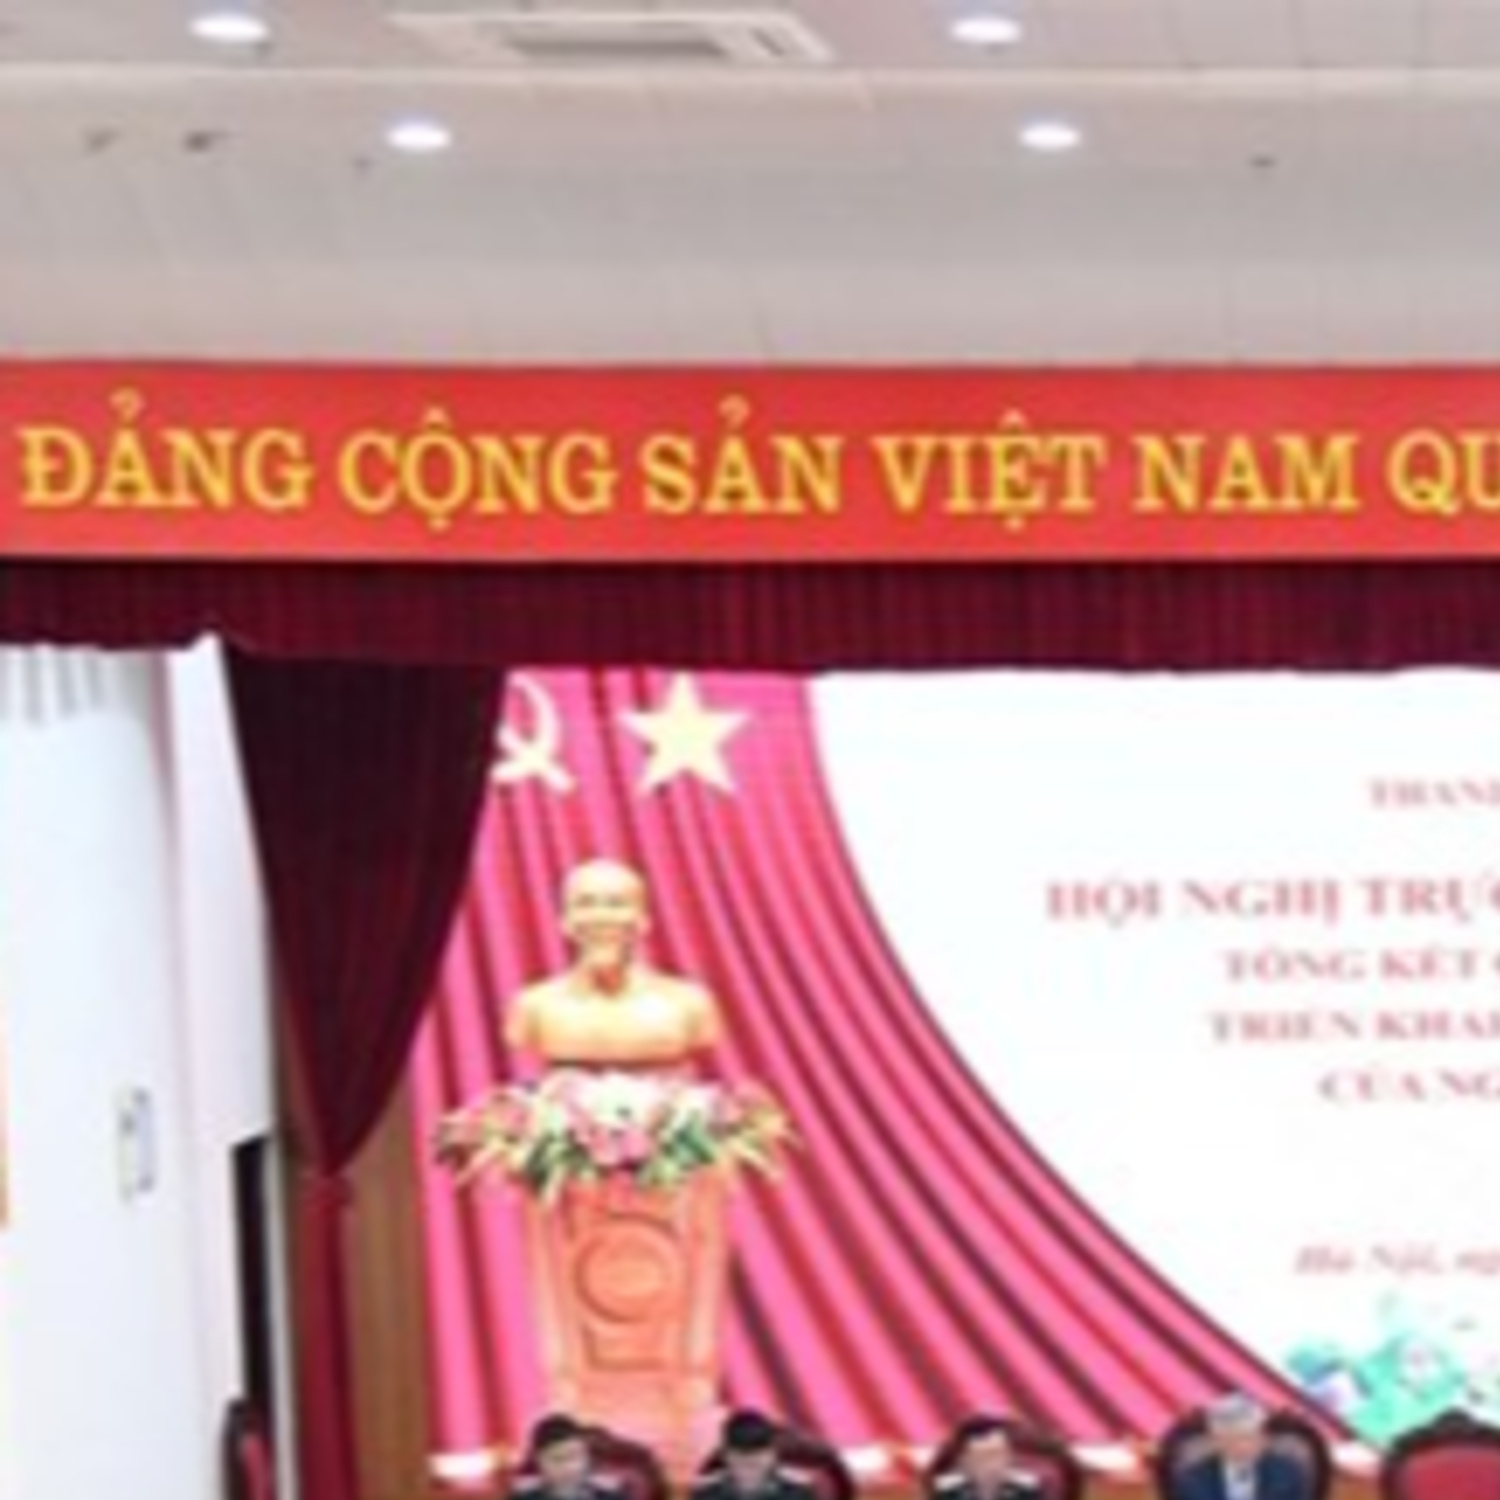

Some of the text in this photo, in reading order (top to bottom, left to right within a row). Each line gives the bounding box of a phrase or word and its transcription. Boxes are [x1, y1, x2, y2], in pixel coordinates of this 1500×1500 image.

[18, 391, 313, 509] ĐẢNG
[338, 409, 618, 527] CỘNG
[640, 397, 842, 513] SẢN
[873, 411, 1106, 529] VIỆT
[1133, 433, 1360, 511] NAM
[1046, 872, 1163, 929] HỘI
[1180, 876, 1343, 927] NGHỊ
